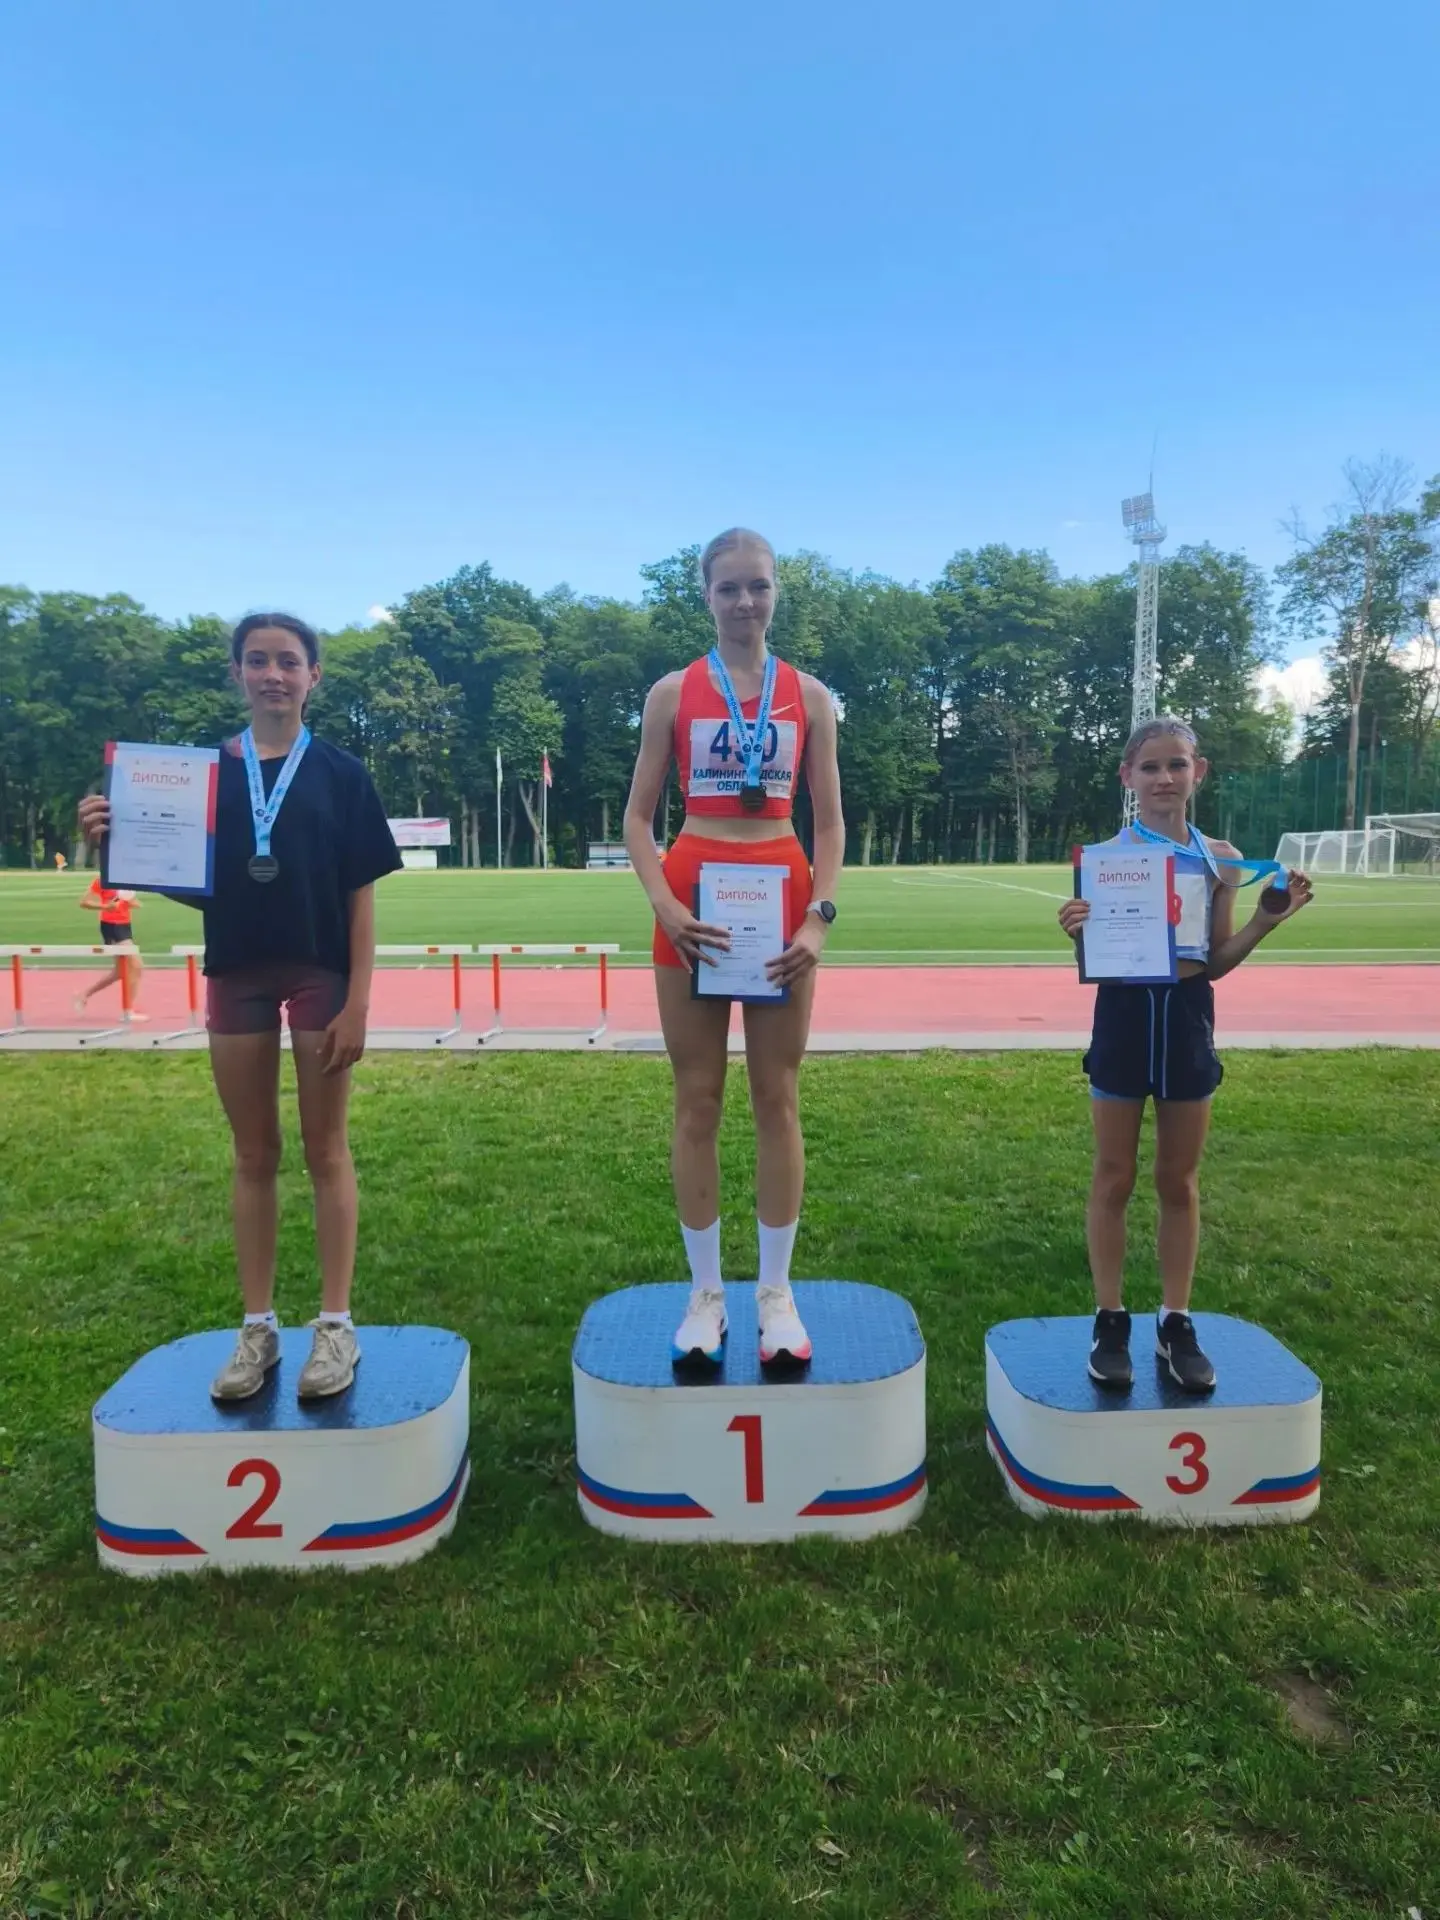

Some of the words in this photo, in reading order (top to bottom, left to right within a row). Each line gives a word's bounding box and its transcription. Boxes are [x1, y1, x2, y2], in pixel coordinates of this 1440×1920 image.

[131, 772, 191, 786] ДИПЛОМ
[693, 768, 792, 781] КАЛИНИНГДСКАЯ
[717, 780, 767, 792] ОБЛАЬ
[1098, 872, 1151, 884] ДИПЛОМ
[716, 890, 768, 901] ДИПЛОМ
[727, 1416, 763, 1502] 1
[1166, 1433, 1209, 1493] 3
[226, 1459, 282, 1539] 2
